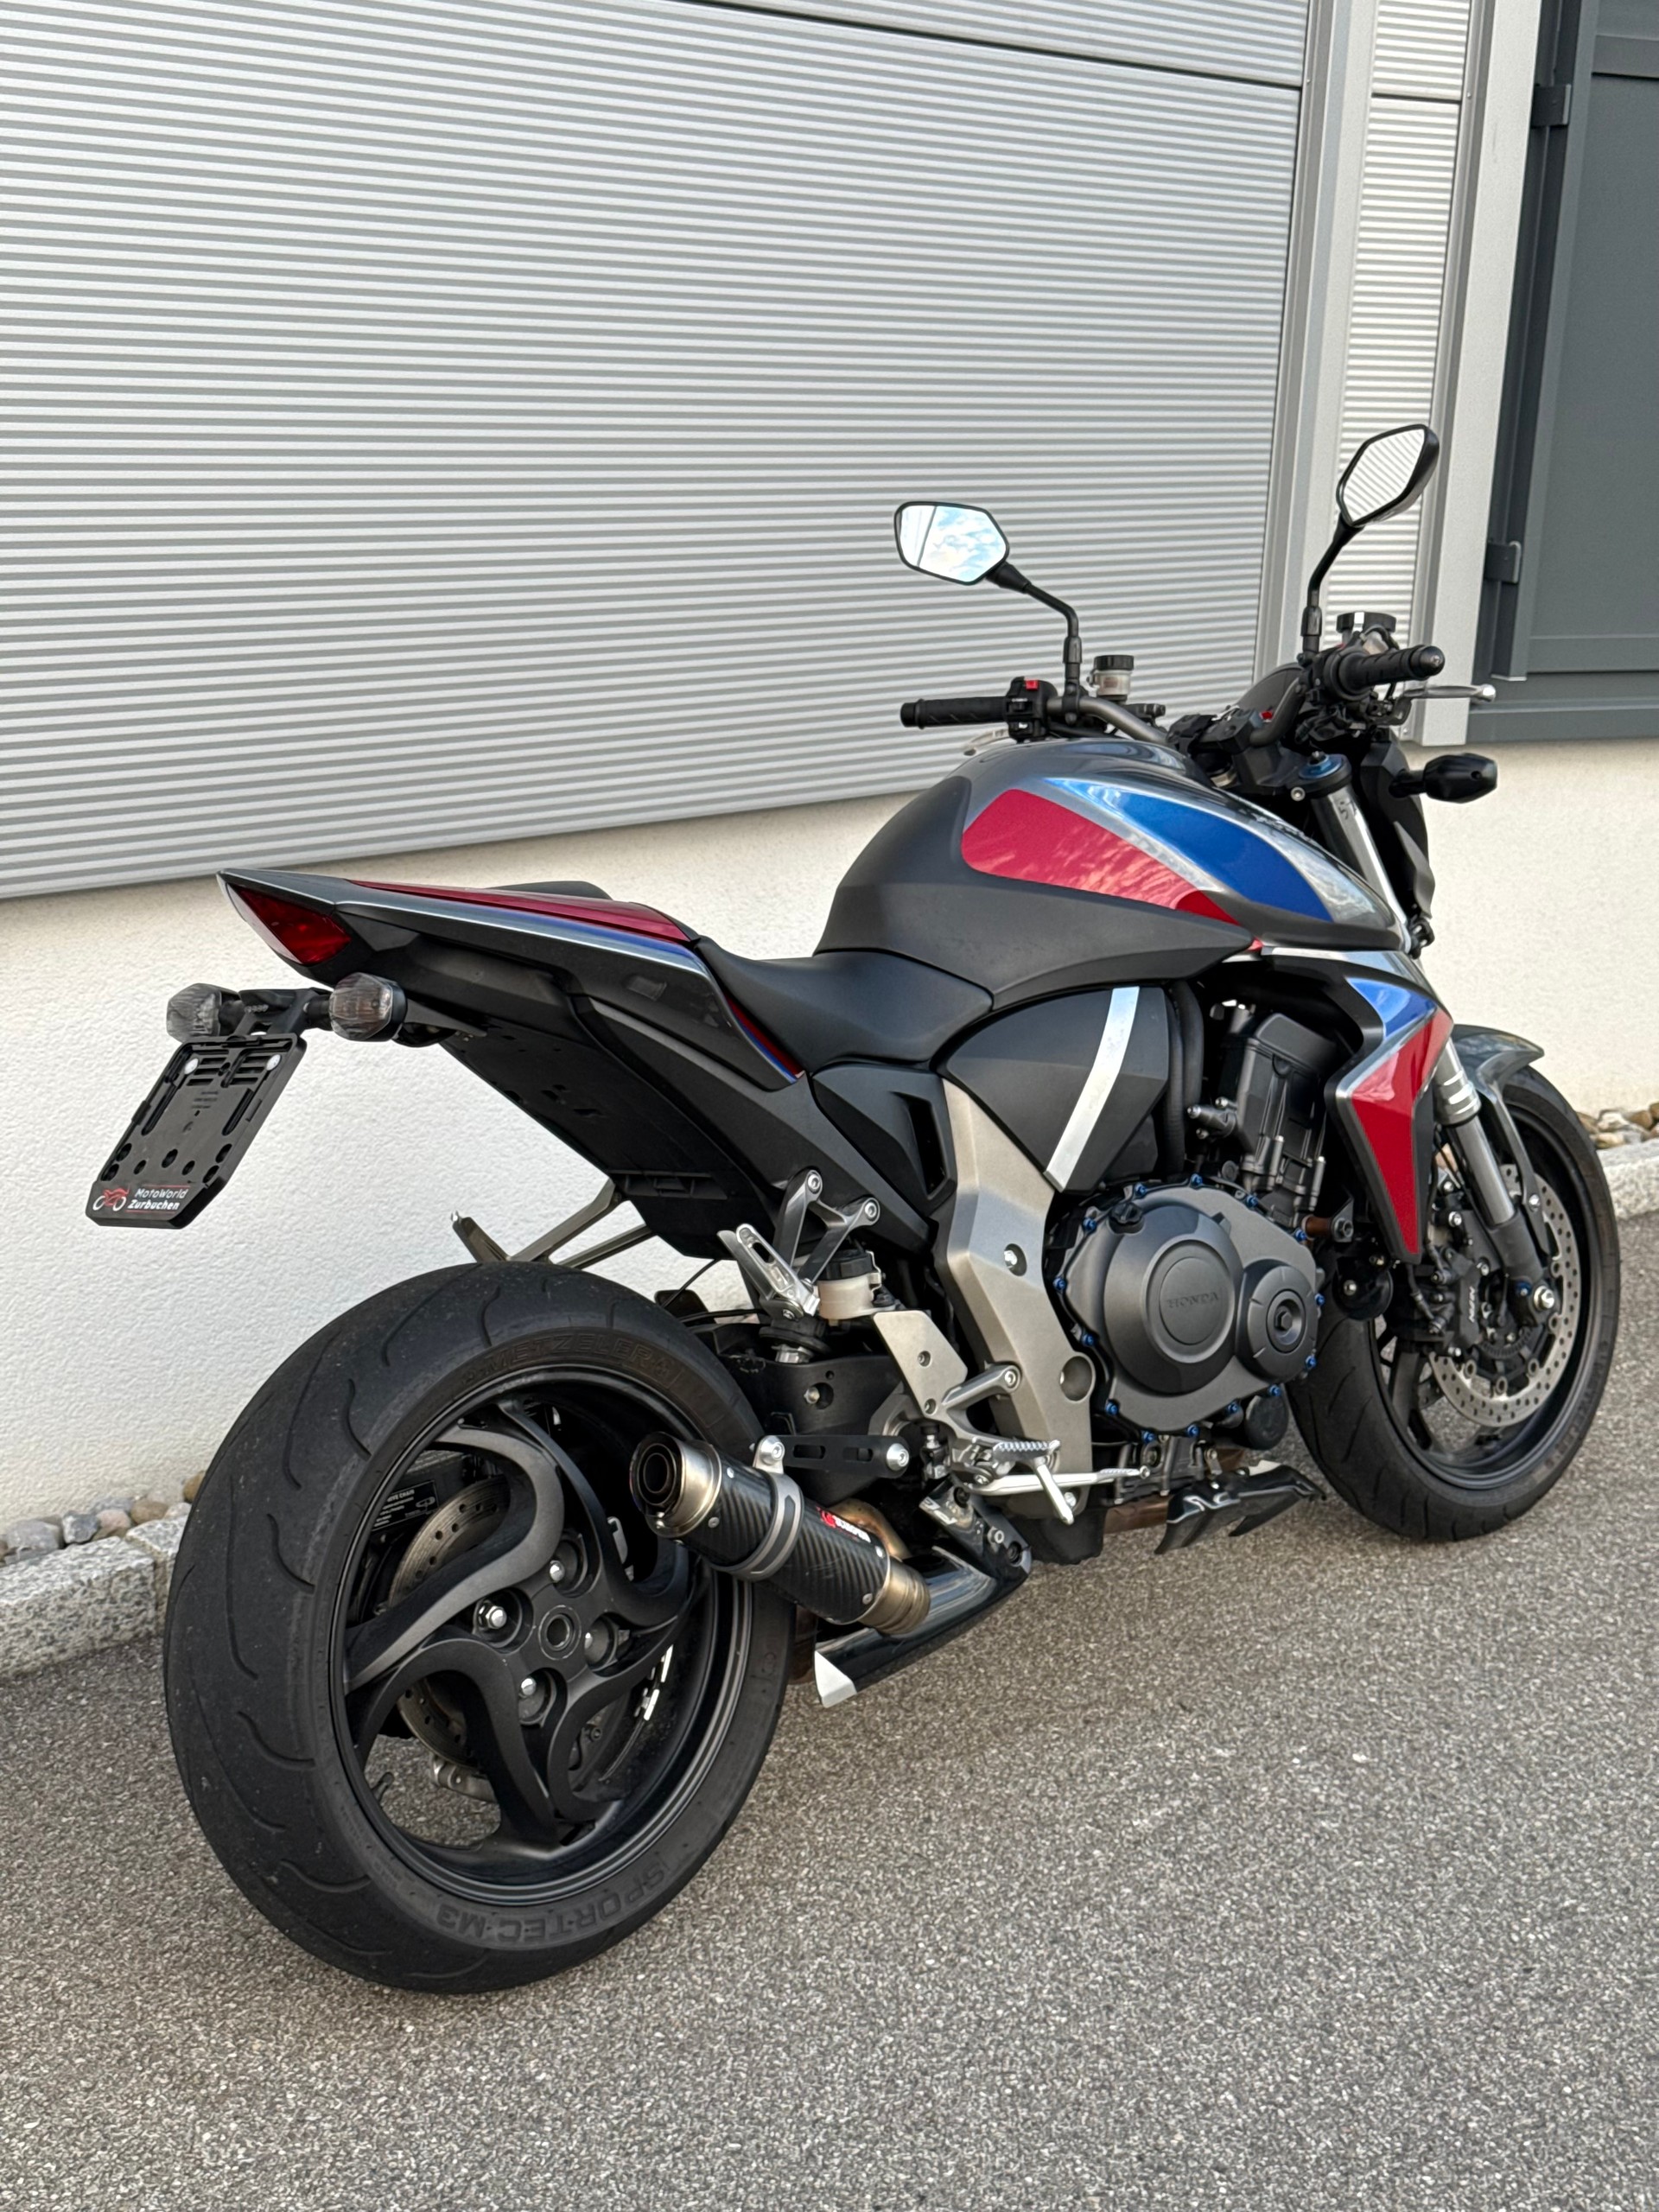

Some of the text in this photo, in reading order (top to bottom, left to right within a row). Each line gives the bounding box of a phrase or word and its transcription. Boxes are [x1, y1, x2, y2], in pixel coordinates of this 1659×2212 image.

[135, 1188, 188, 1199] MotoWorld
[127, 1199, 180, 1210] Zurbuchen
[1166, 1292, 1219, 1308] HONDA
[485, 1333, 653, 1370] METZELER
[436, 1864, 664, 1942] SPORTEC M3
